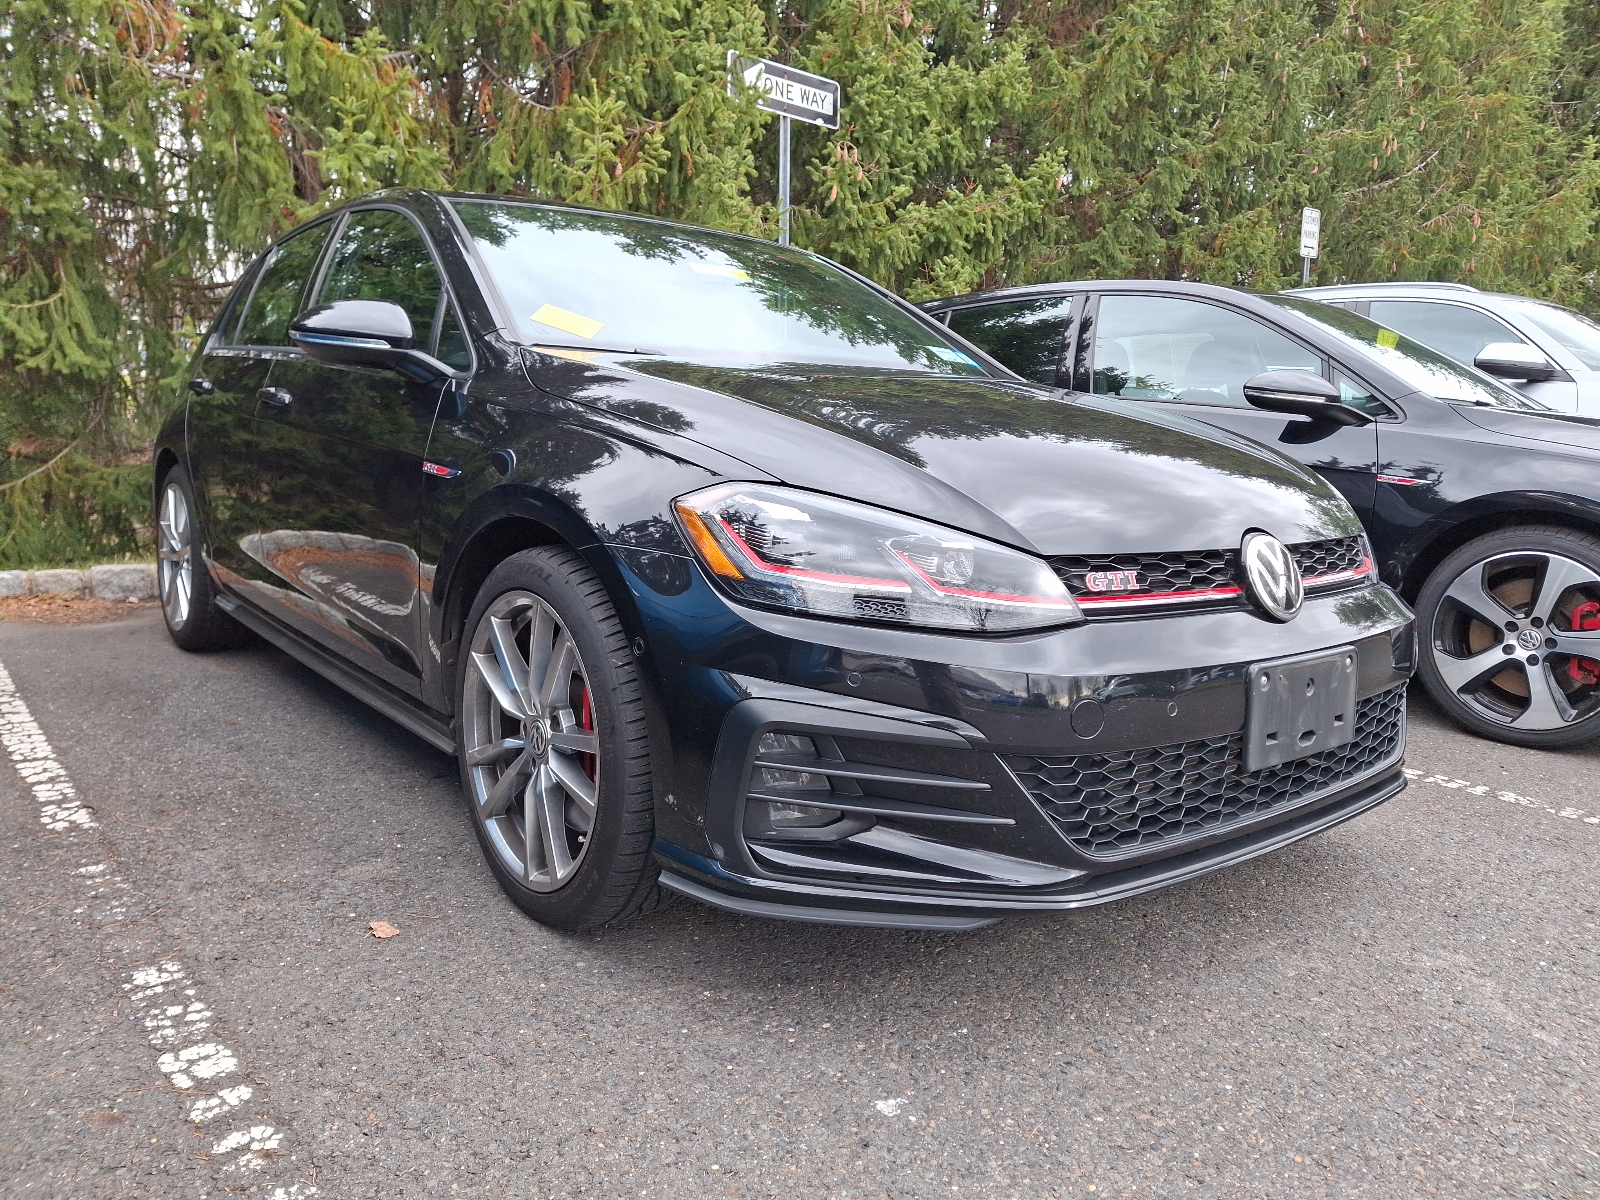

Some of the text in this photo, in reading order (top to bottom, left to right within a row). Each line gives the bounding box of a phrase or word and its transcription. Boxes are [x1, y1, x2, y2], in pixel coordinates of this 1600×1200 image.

[763, 77, 828, 111] ONE WAY
[1085, 570, 1140, 592] GTI
